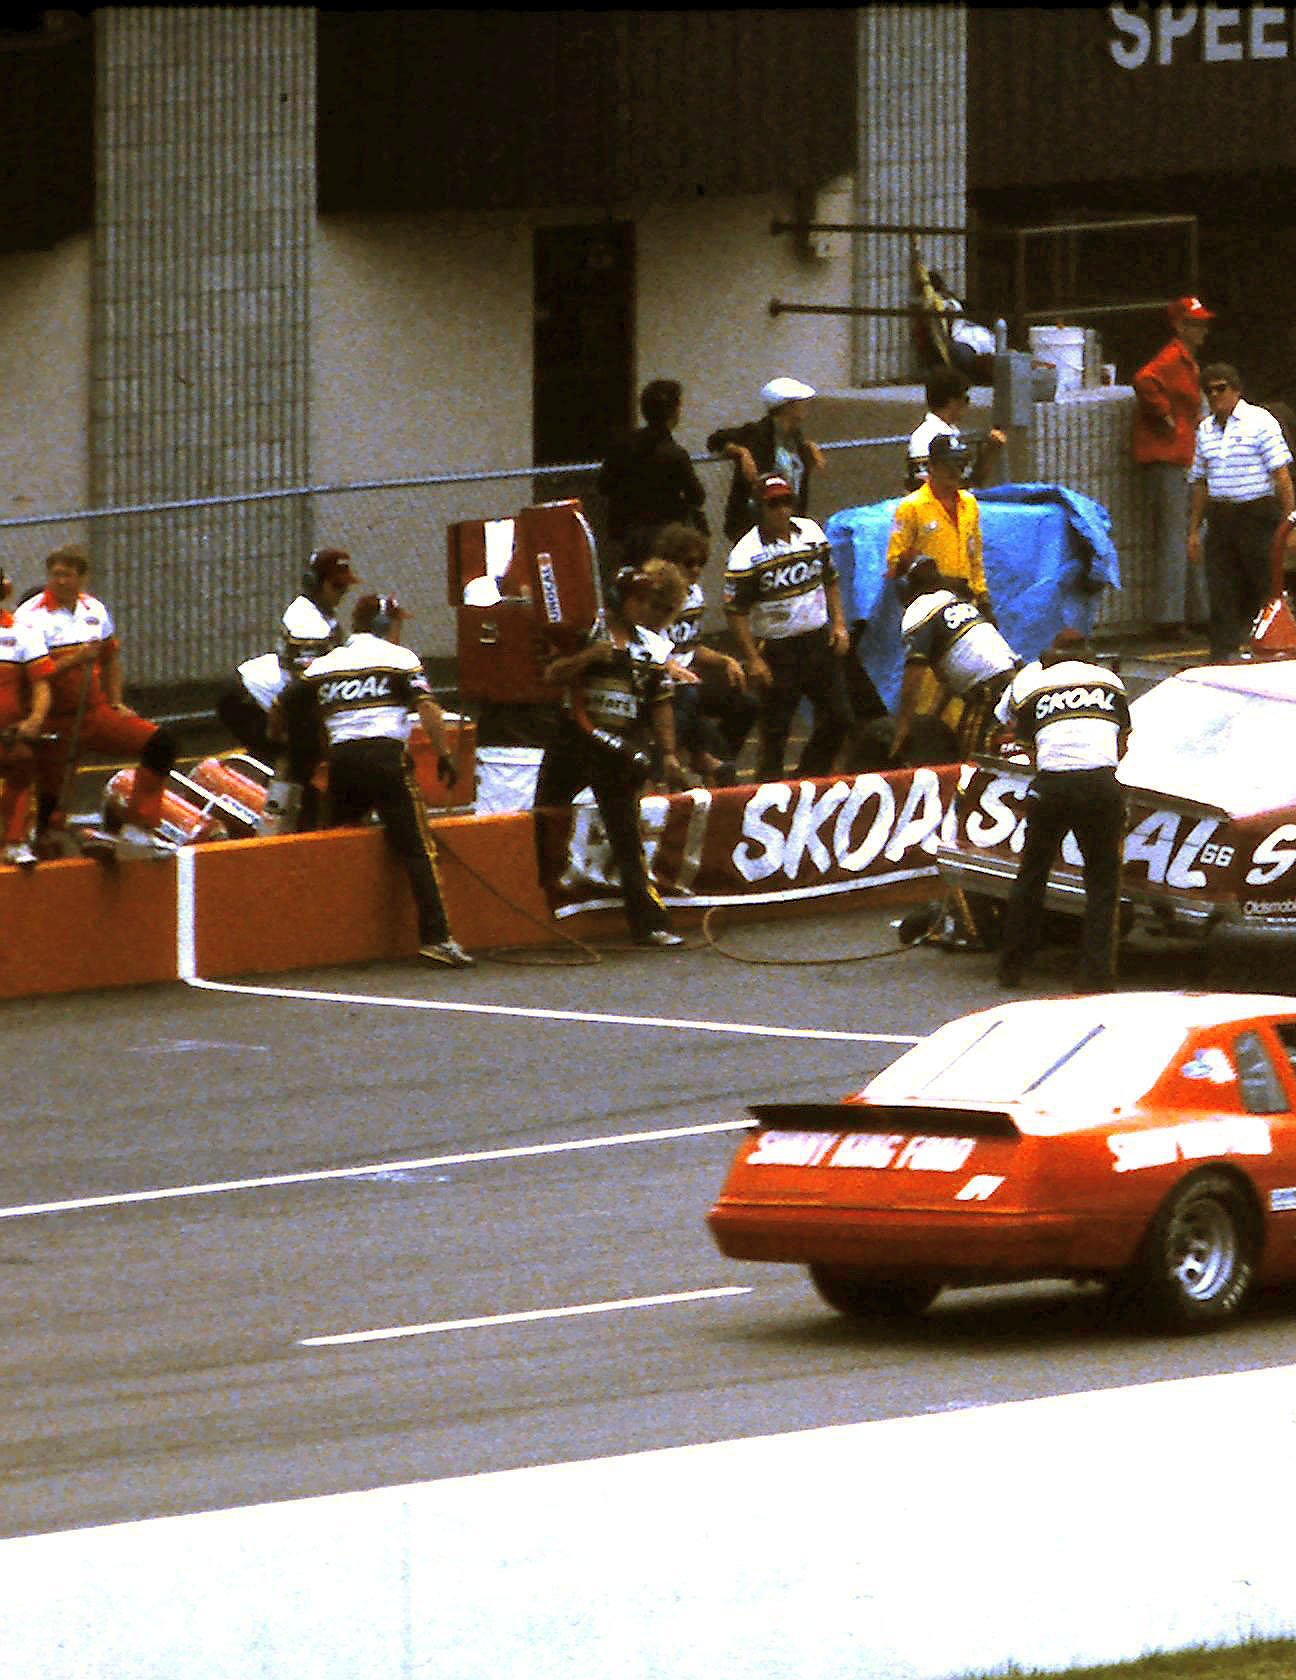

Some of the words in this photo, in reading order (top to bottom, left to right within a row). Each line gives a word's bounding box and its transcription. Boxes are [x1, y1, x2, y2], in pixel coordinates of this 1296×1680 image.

[320, 674, 392, 705] SKOAL
[1036, 686, 1116, 720] SKOAL
[1200, 842, 1235, 867] 66
